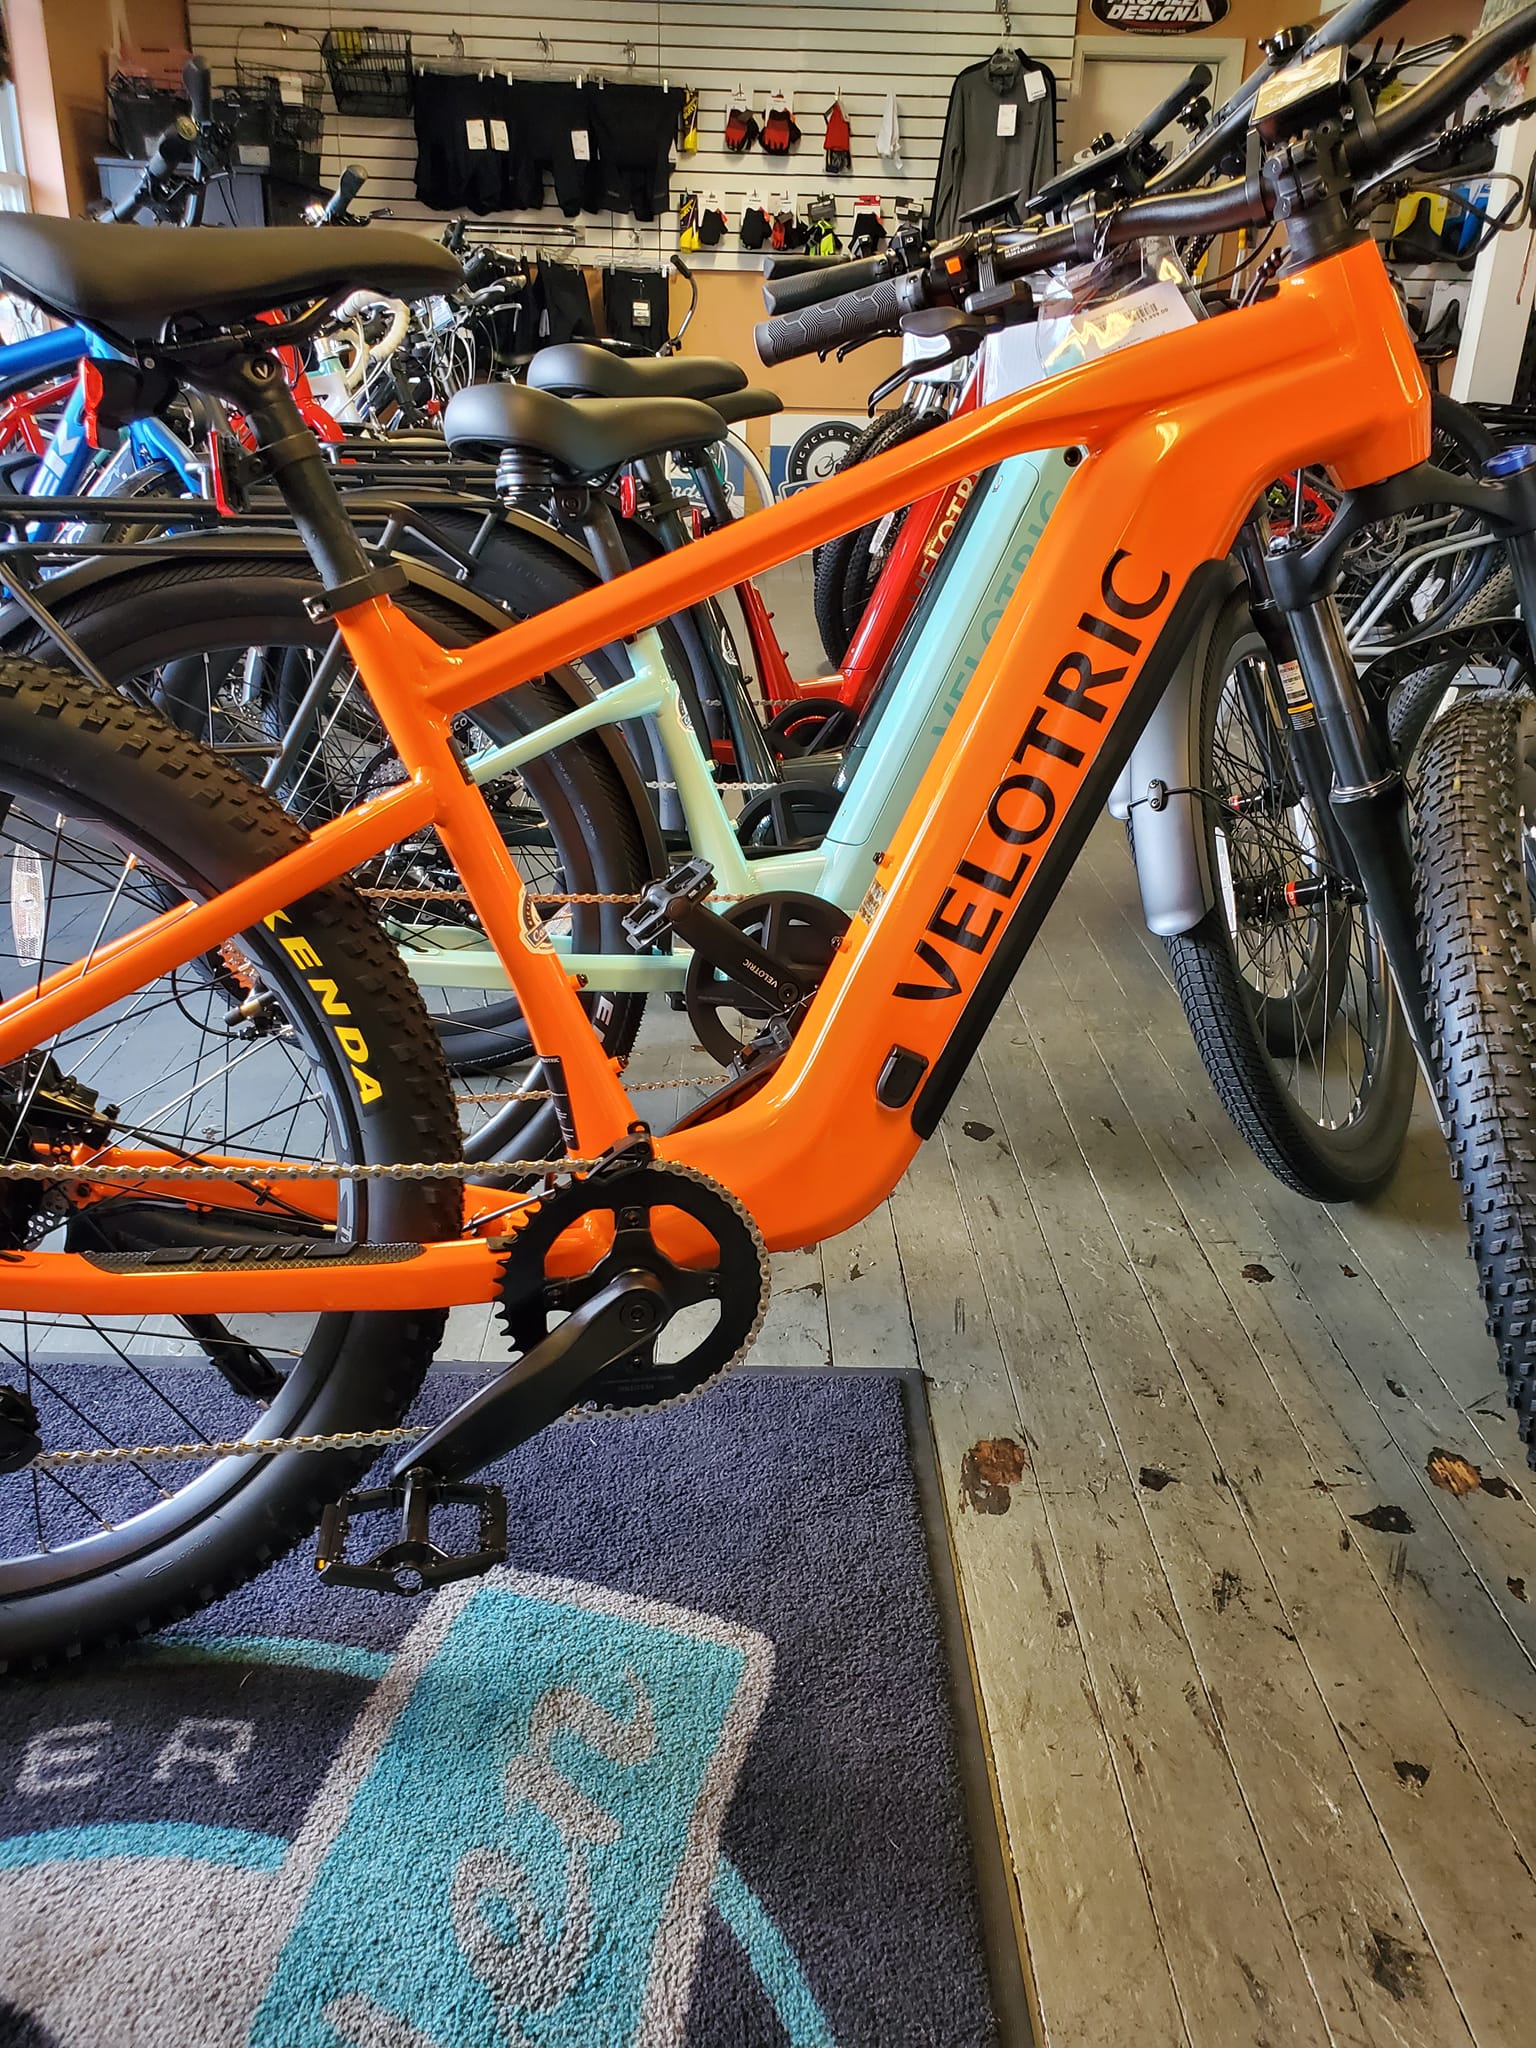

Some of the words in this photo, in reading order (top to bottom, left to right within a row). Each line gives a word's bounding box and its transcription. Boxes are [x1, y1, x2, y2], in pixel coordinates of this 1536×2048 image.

[1106, 6, 1190, 21] DESIGN
[931, 490, 1058, 737] VEOTRIC
[891, 547, 1171, 1001] VELOTRIC
[263, 909, 384, 1105] KENDA
[742, 958, 778, 989] VELOTRIC
